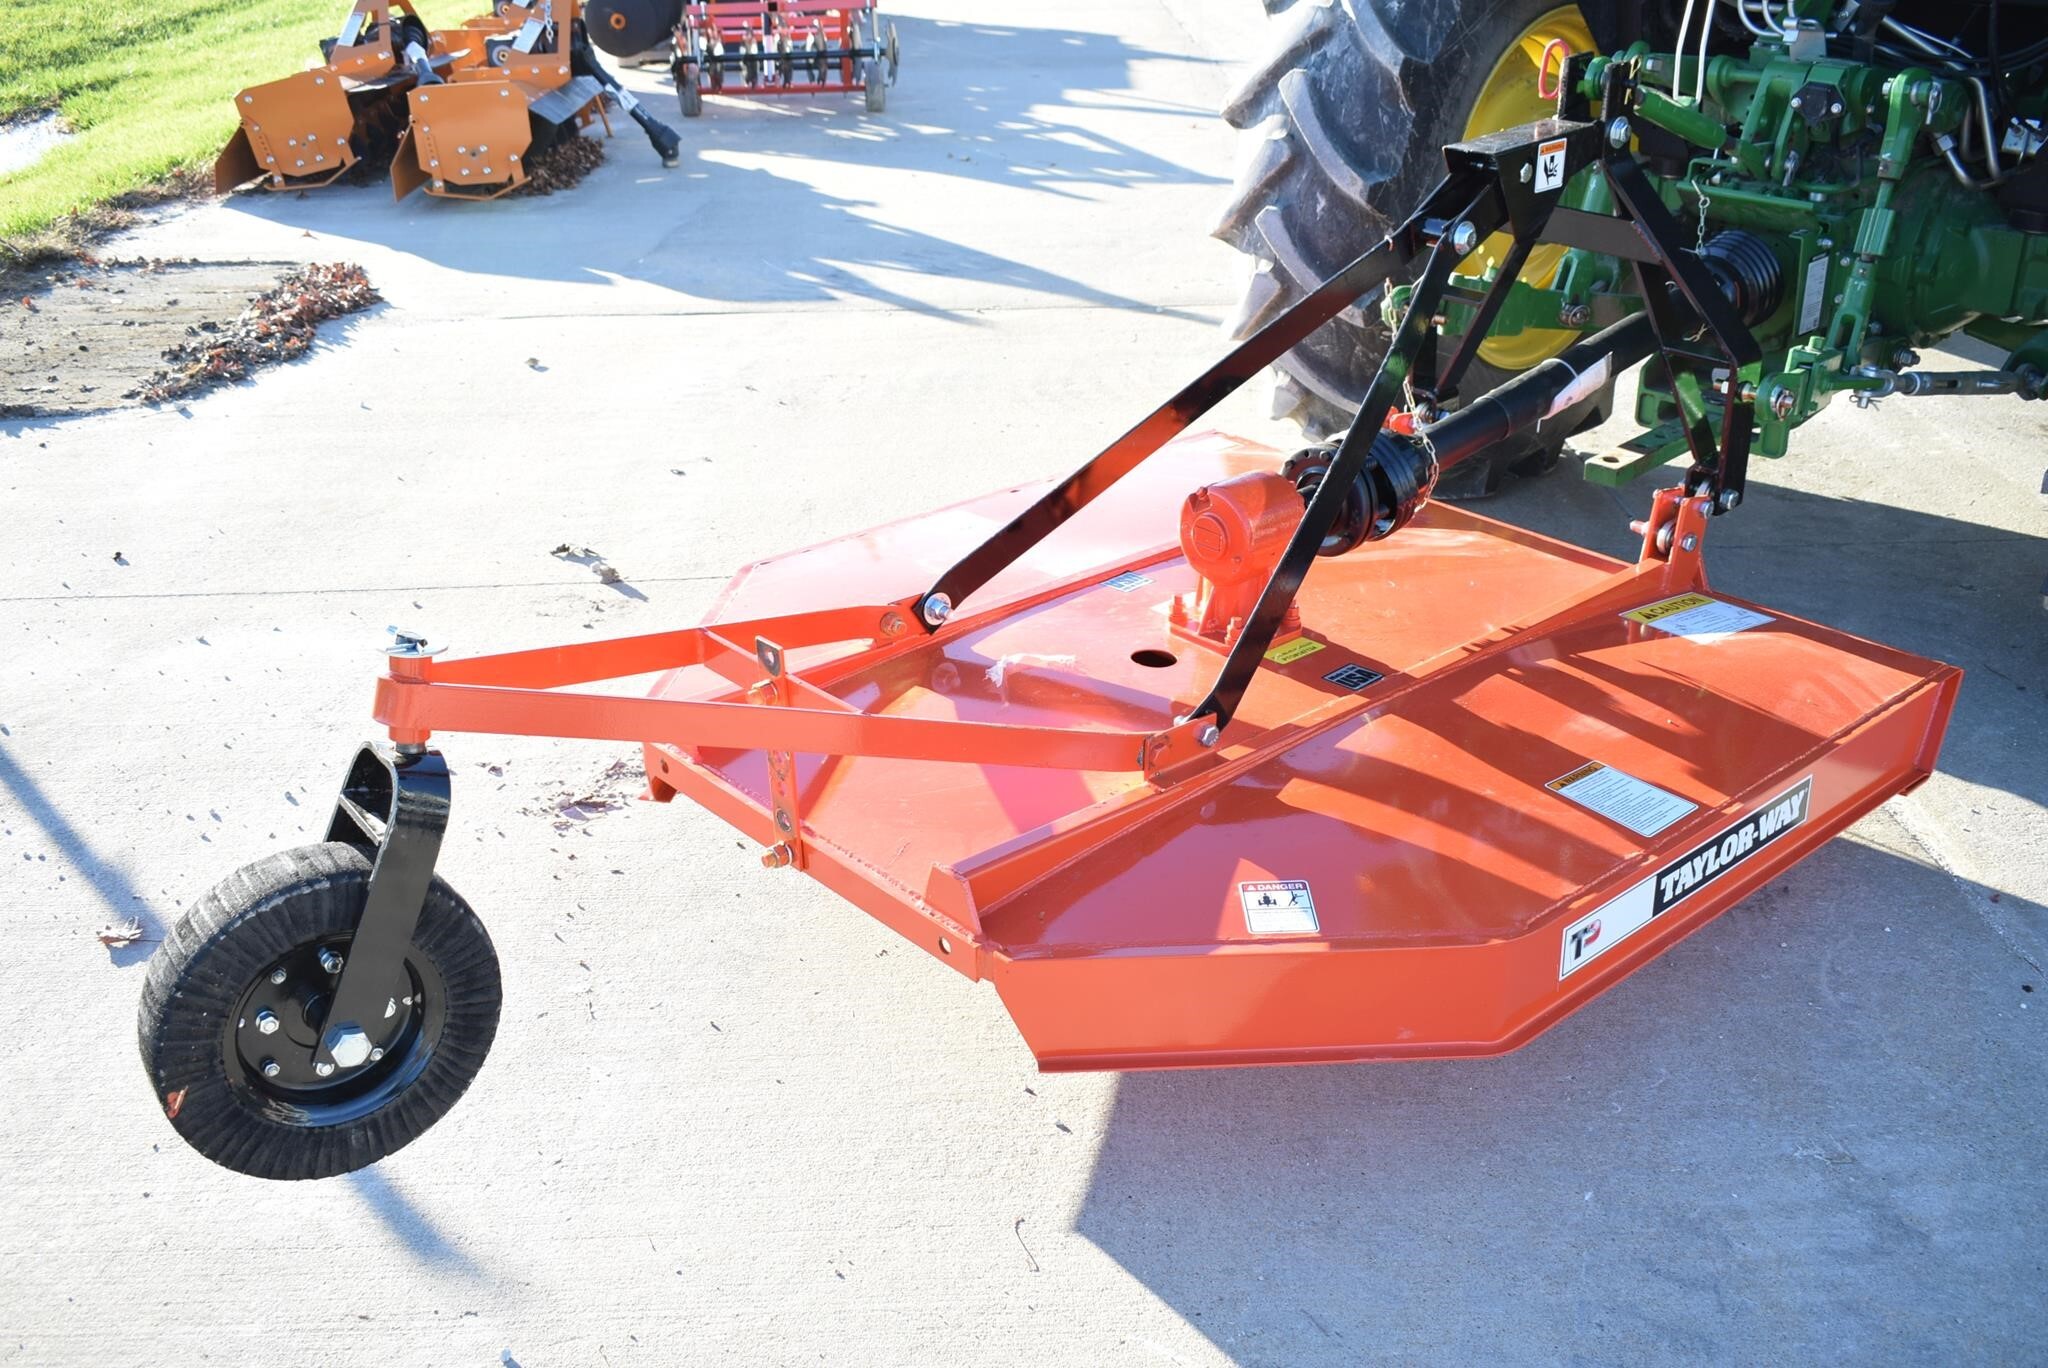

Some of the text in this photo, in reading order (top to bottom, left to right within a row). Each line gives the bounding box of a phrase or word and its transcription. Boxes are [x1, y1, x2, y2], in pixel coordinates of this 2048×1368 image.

[1653, 596, 1705, 616] CAUTION
[1336, 668, 1379, 688] USA
[1563, 766, 1598, 784] WARNING
[1660, 789, 1806, 903] TAYLOR-WAY
[1257, 883, 1303, 891] DANGER
